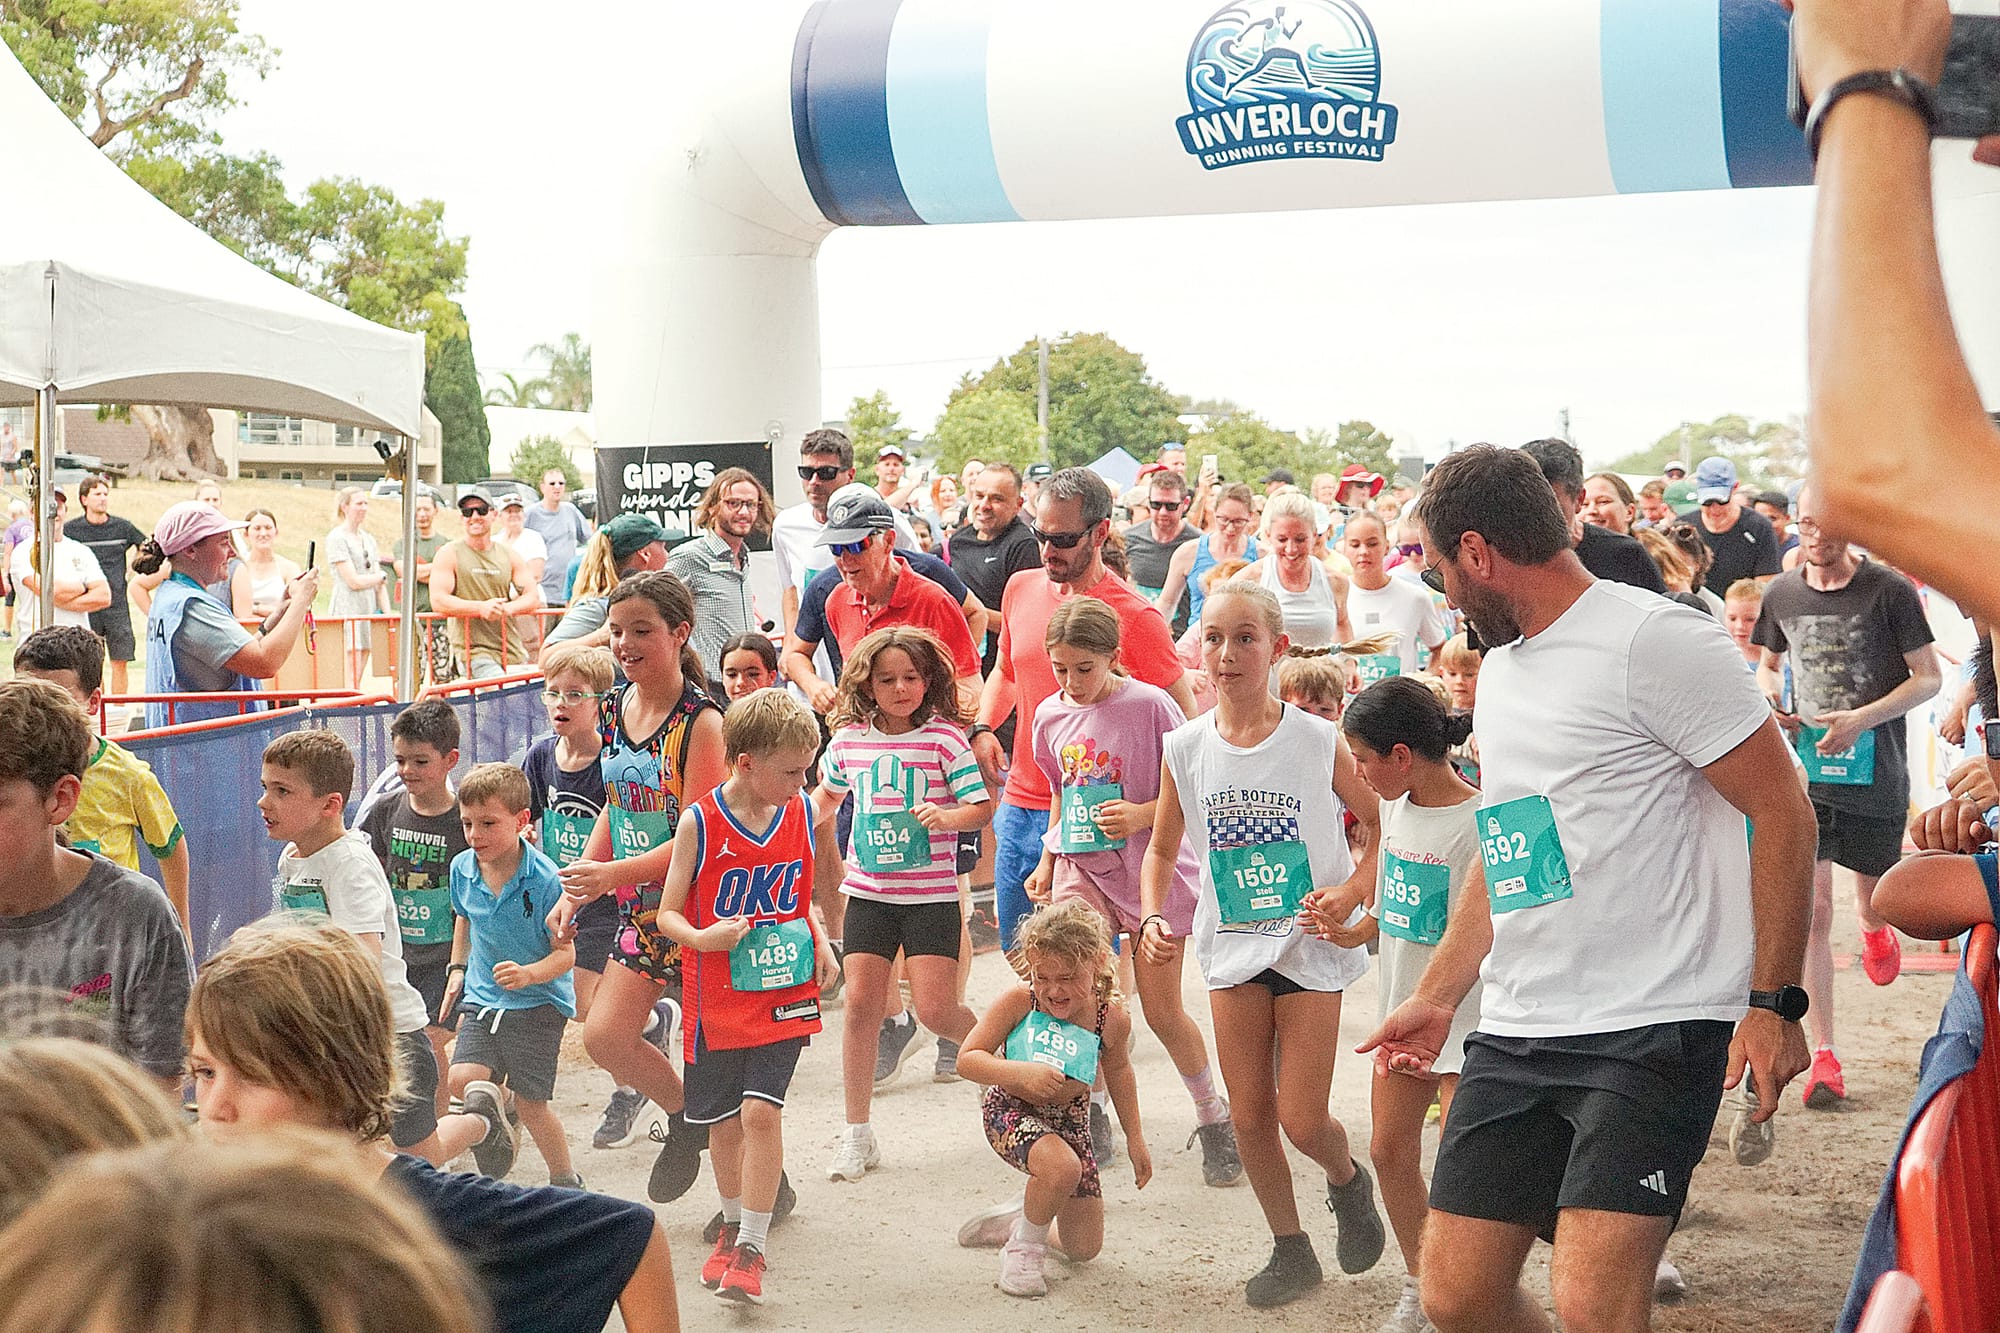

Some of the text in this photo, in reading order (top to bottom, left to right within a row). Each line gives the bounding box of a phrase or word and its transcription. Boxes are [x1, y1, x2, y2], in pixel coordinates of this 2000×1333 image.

[1187, 102, 1386, 149] INVERLOCH
[1203, 141, 1381, 167] RUNNING FESTIVAL
[623, 461, 715, 490] GIPPS
[621, 483, 704, 509] wonde
[625, 510, 704, 537] AND
[1360, 666, 1388, 679] 547
[606, 781, 680, 830] ARRIORS
[1241, 789, 1302, 812] BOTTEGA
[1066, 804, 1101, 823] 1496
[392, 827, 448, 847] SURVIVAL
[554, 827, 589, 849] 1497
[618, 826, 650, 848] 1510
[866, 828, 910, 846] 1504
[1481, 832, 1531, 867] 1592
[391, 839, 448, 863] MODE!
[1233, 863, 1289, 889] 1502
[713, 859, 803, 919] OKC
[1384, 875, 1421, 906] 1593
[398, 905, 431, 920] 529
[748, 942, 798, 967] 1483
[762, 965, 791, 976] Harvey
[1027, 1027, 1078, 1057] 1489
